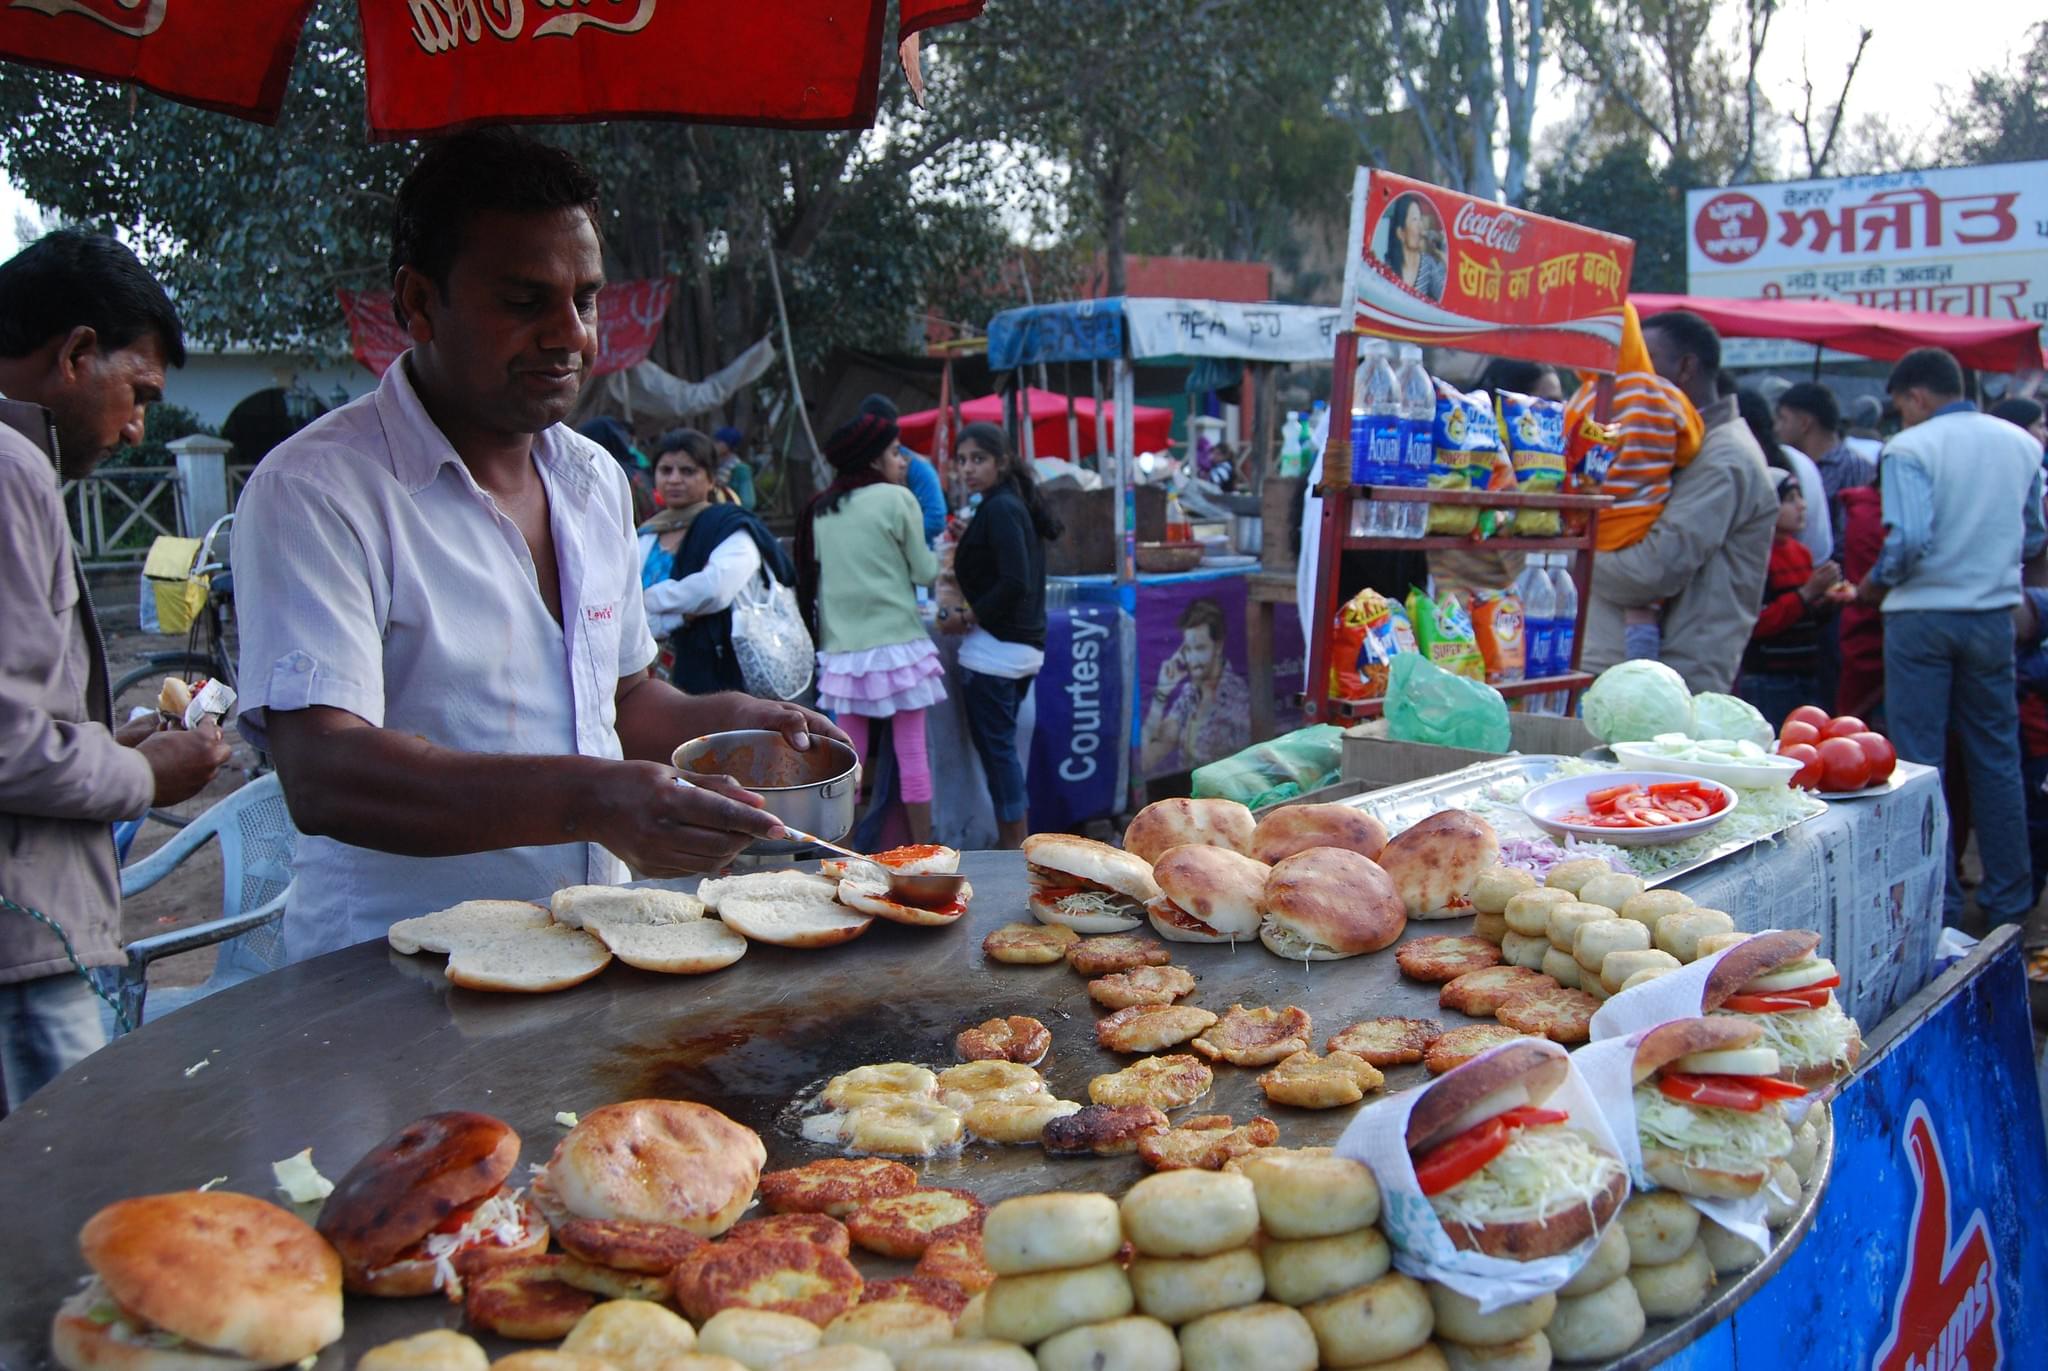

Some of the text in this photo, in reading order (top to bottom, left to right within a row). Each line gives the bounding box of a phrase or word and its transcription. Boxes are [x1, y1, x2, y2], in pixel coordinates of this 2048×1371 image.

[1776, 187, 2021, 253] ਅਜੀਤ
[1458, 250, 1505, 303] खाने
[1508, 265, 1535, 301] का
[1537, 252, 1581, 295] स्वाद
[1058, 607, 1110, 782] Courtesy:
